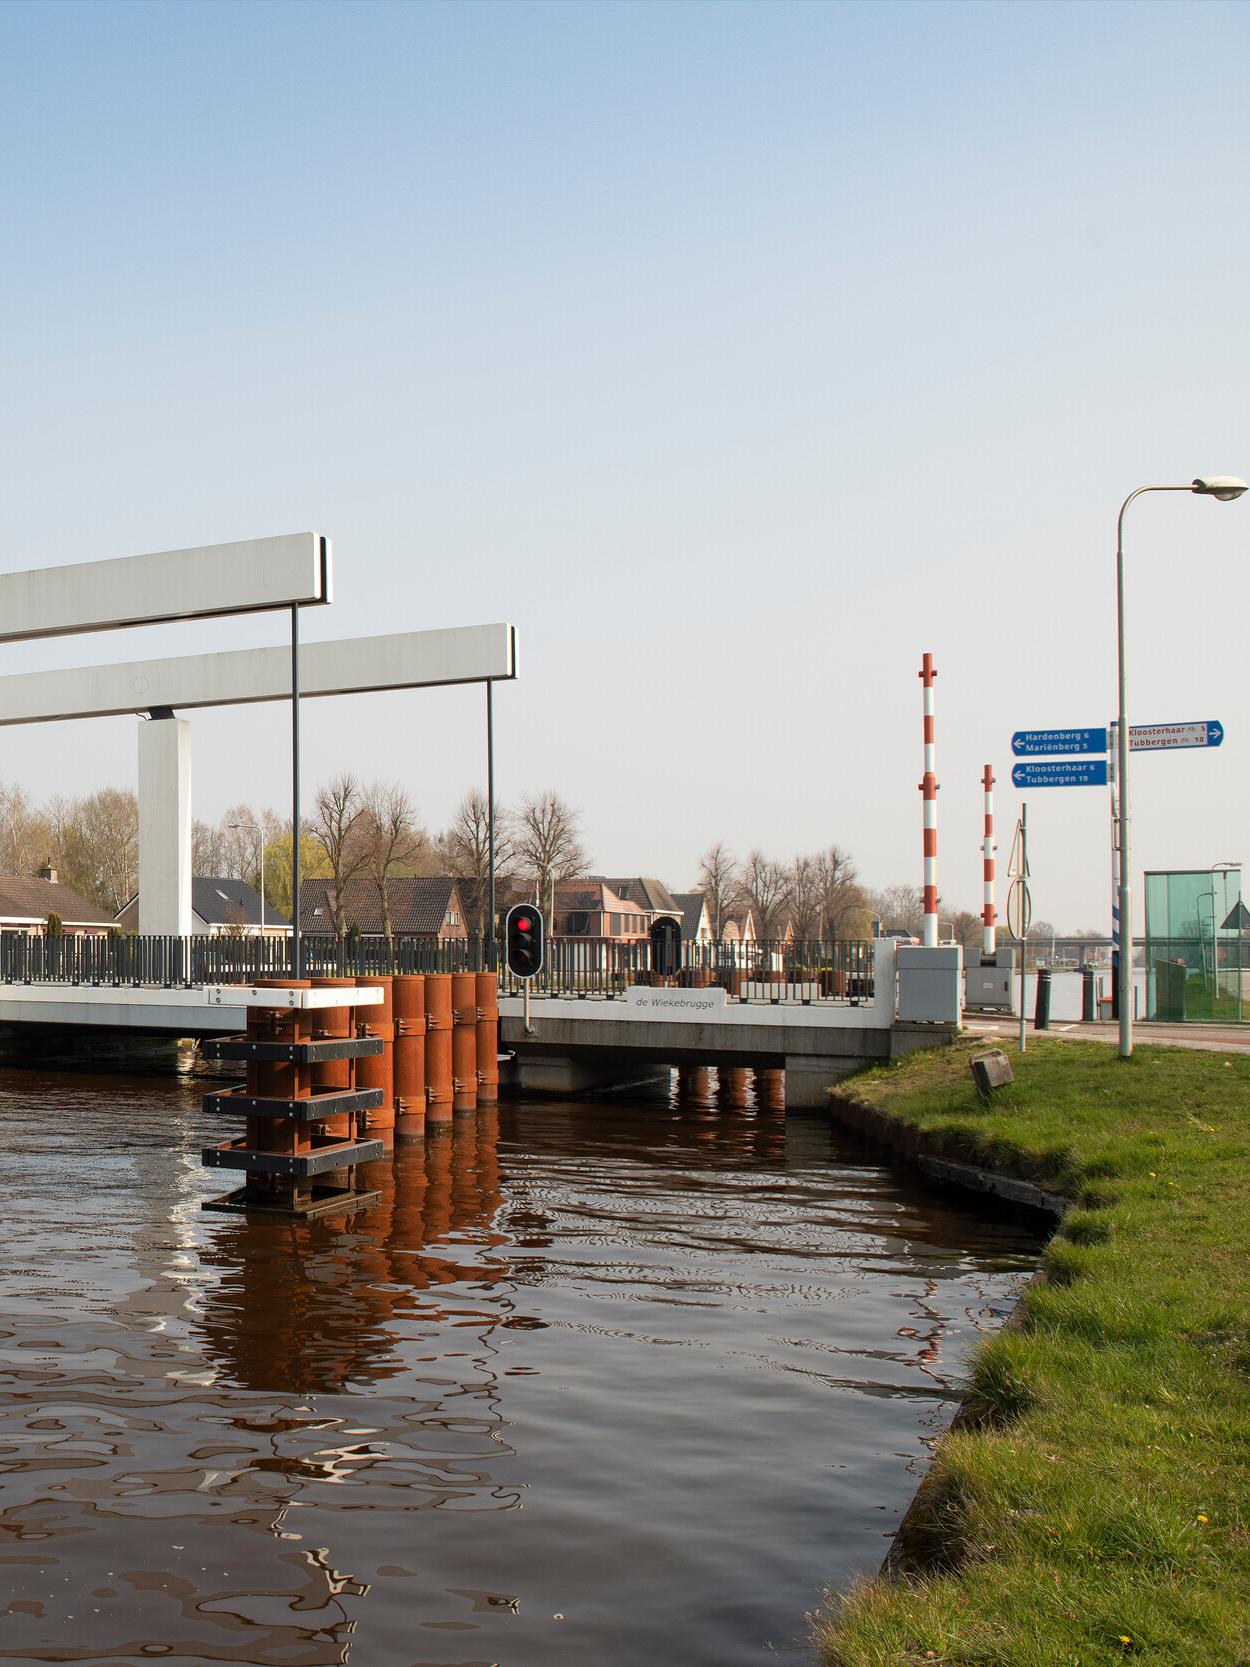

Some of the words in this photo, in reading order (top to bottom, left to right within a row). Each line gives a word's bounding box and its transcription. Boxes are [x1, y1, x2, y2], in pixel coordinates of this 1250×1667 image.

[1025, 732, 1081, 742] Hardenberg
[1129, 727, 1185, 737] Kloosterhaar
[1129, 737, 1178, 747] Tubbergen
[1025, 743, 1080, 752] Mariënberg
[1026, 764, 1087, 773] Kloosterhaar
[1026, 775, 1077, 784] Tubbergen
[636, 998, 648, 1007] de
[651, 998, 714, 1010] Wiekebrugge
